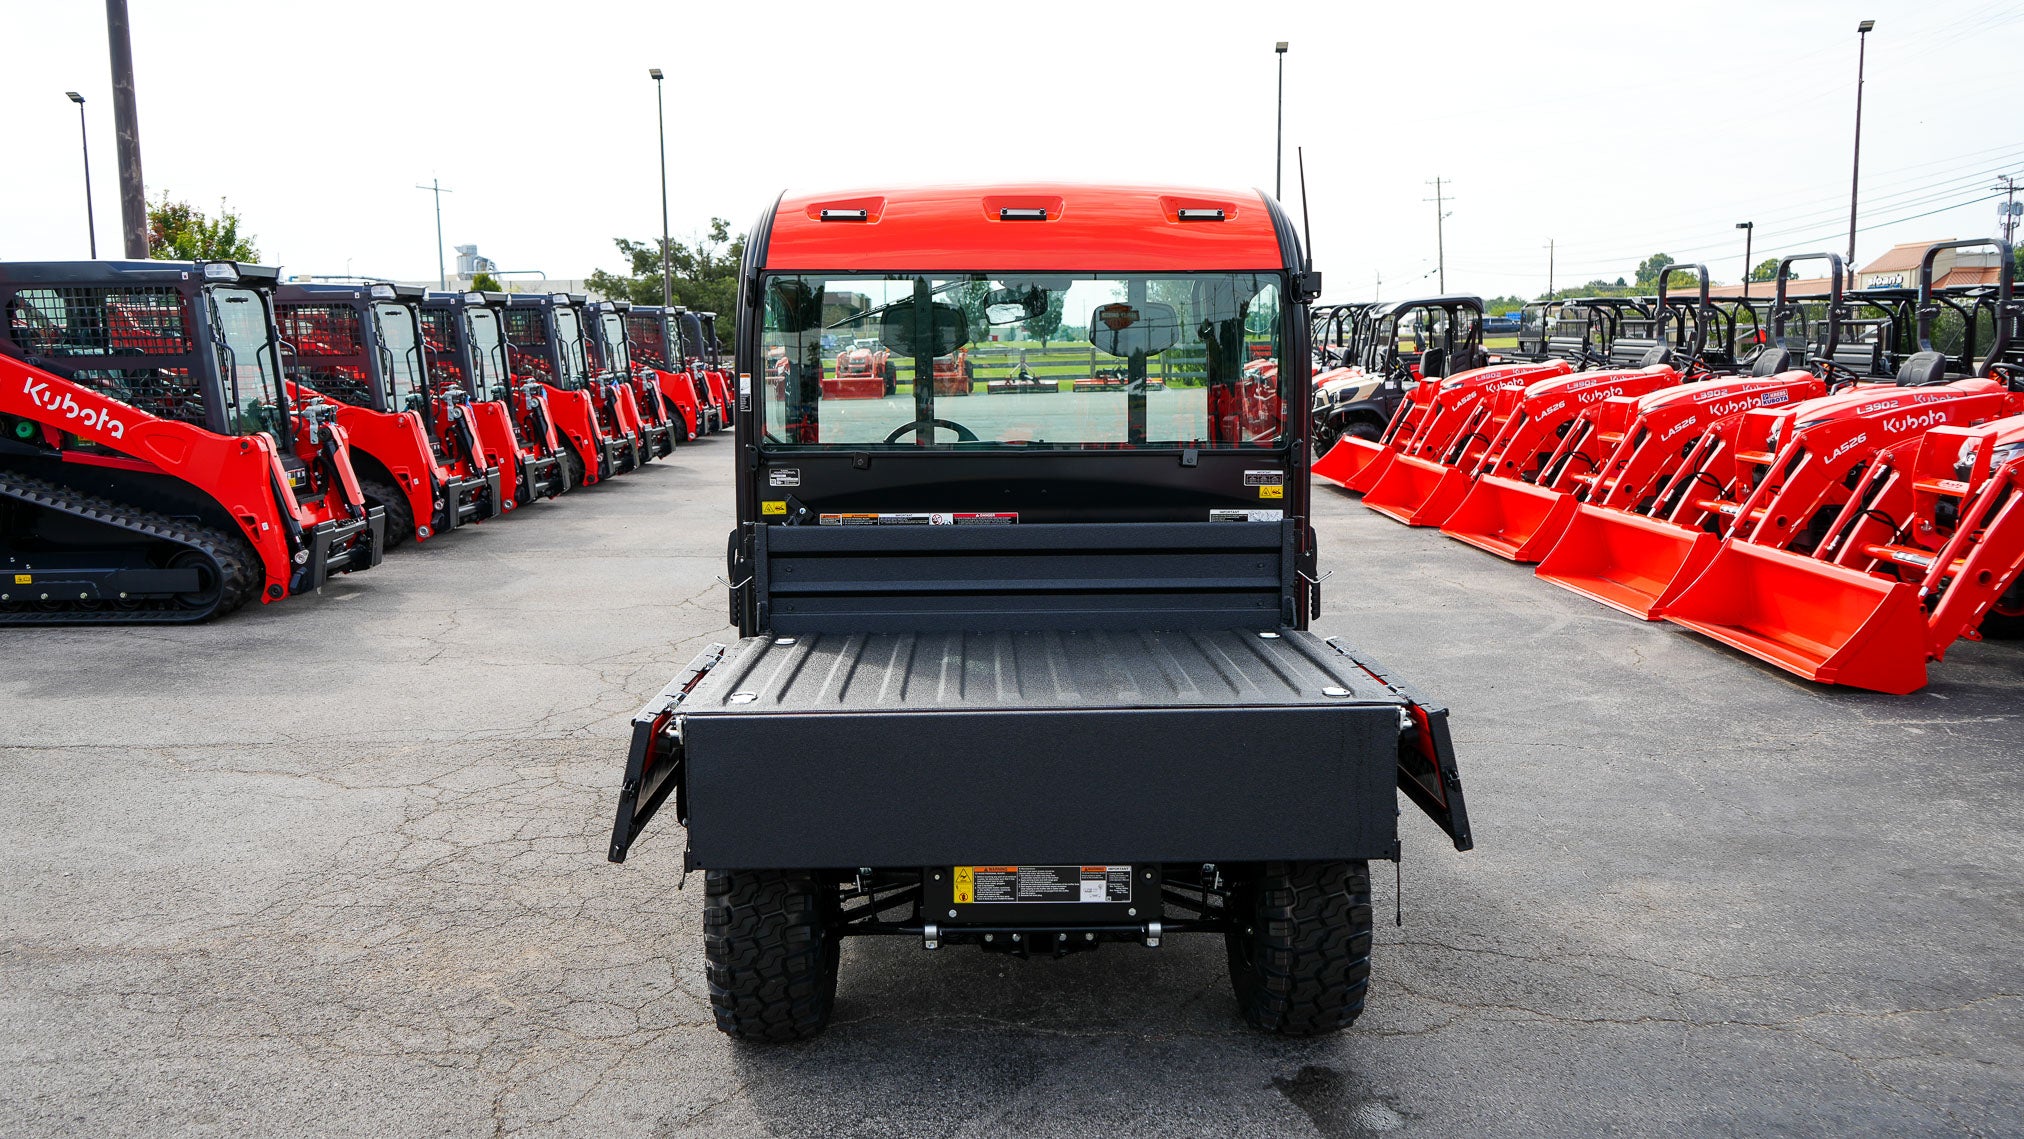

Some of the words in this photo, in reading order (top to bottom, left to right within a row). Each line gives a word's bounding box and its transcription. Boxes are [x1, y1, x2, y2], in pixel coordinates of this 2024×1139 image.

[1867, 273, 1903, 285] sloan's
[1486, 377, 1524, 393] Kubota
[1578, 386, 1623, 404] Kubota
[1693, 389, 1728, 401] L3902
[1763, 396, 1788, 405] KUBOTA
[23, 376, 125, 439] Kubota
[1534, 400, 1566, 422] LA526
[1709, 396, 1762, 416] Kubota
[1856, 399, 1899, 415] L3902
[1660, 415, 1697, 442] LA526
[1883, 409, 1947, 433] Kubota
[1823, 432, 1867, 465] LA526
